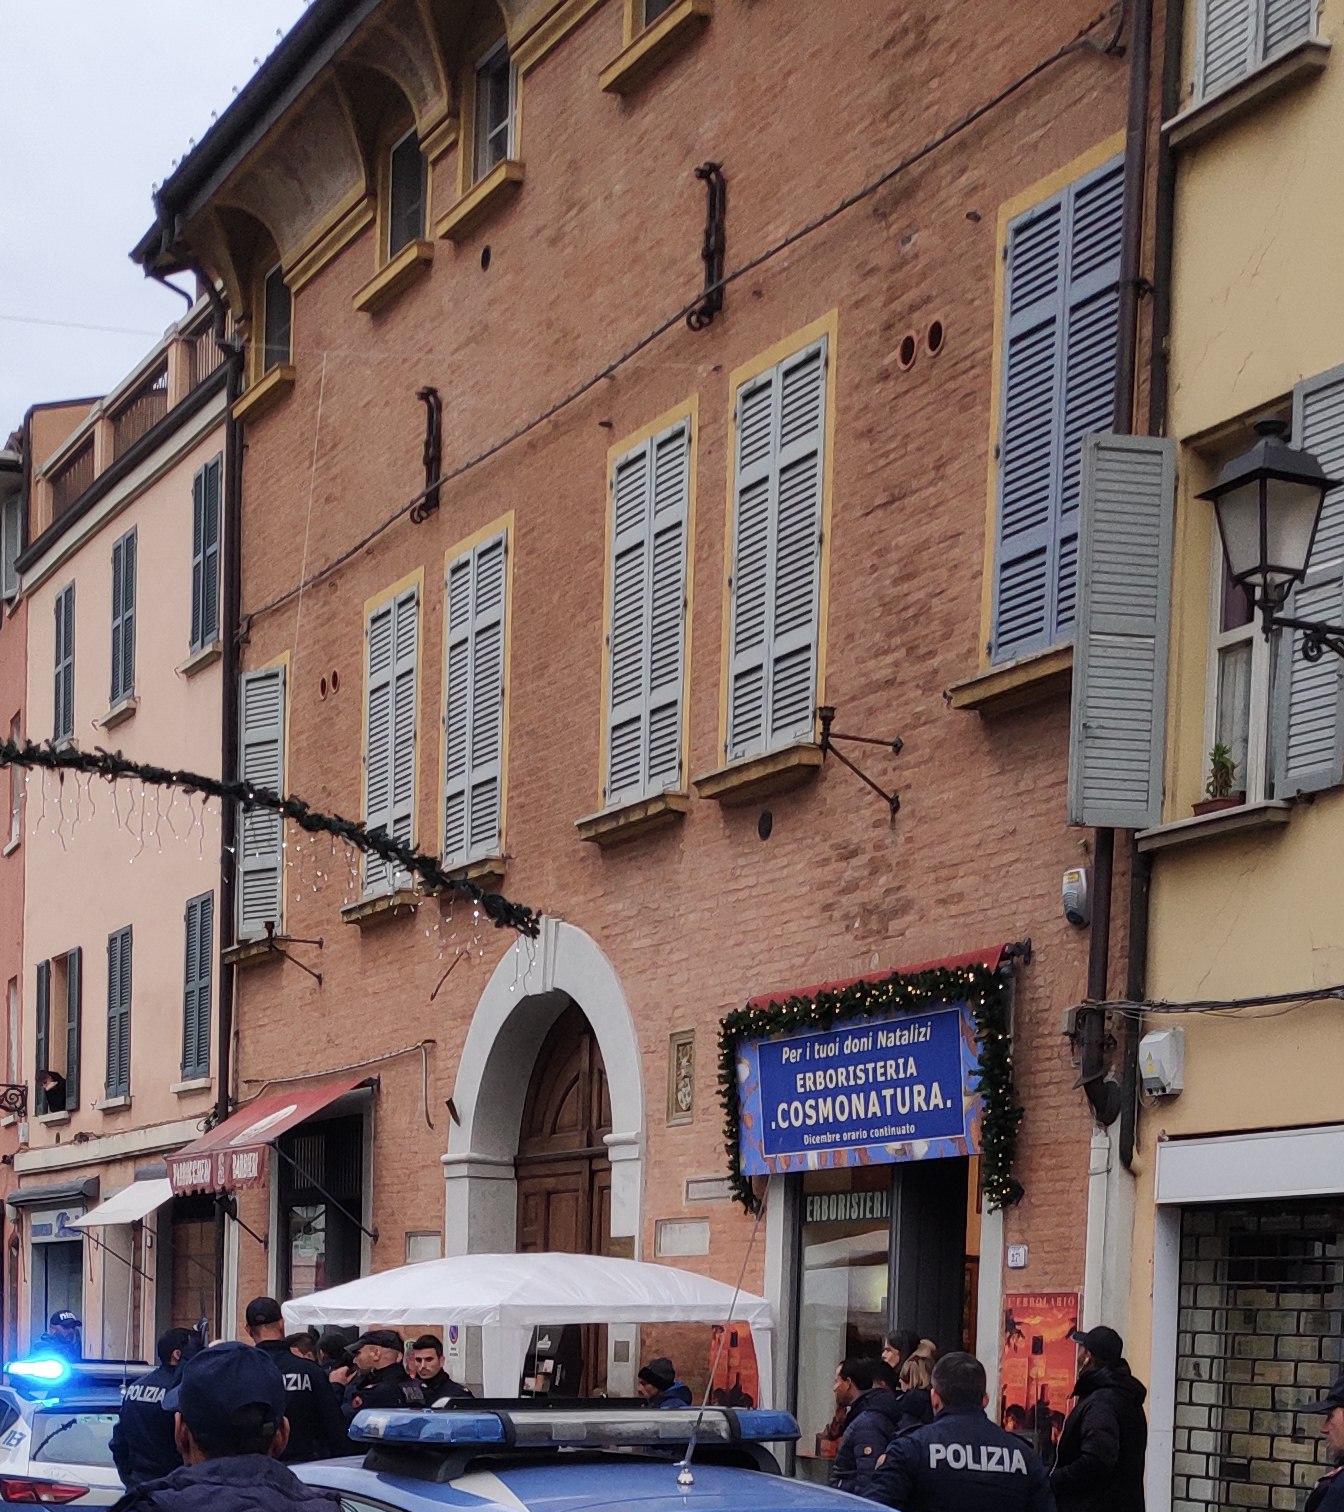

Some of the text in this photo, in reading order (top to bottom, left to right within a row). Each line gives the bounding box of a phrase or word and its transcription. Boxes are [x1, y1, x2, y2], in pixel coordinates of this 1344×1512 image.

[782, 1021, 932, 1064] Per i tuoi doni Natalizi
[796, 1056, 918, 1093] ERBORISTERIA
[803, 1124, 916, 1146] Dicembre orario continuato
[125, 1384, 166, 1403] POLIZIA
[282, 1373, 312, 1391] IZIA
[928, 1443, 1028, 1475] POLIZIA
